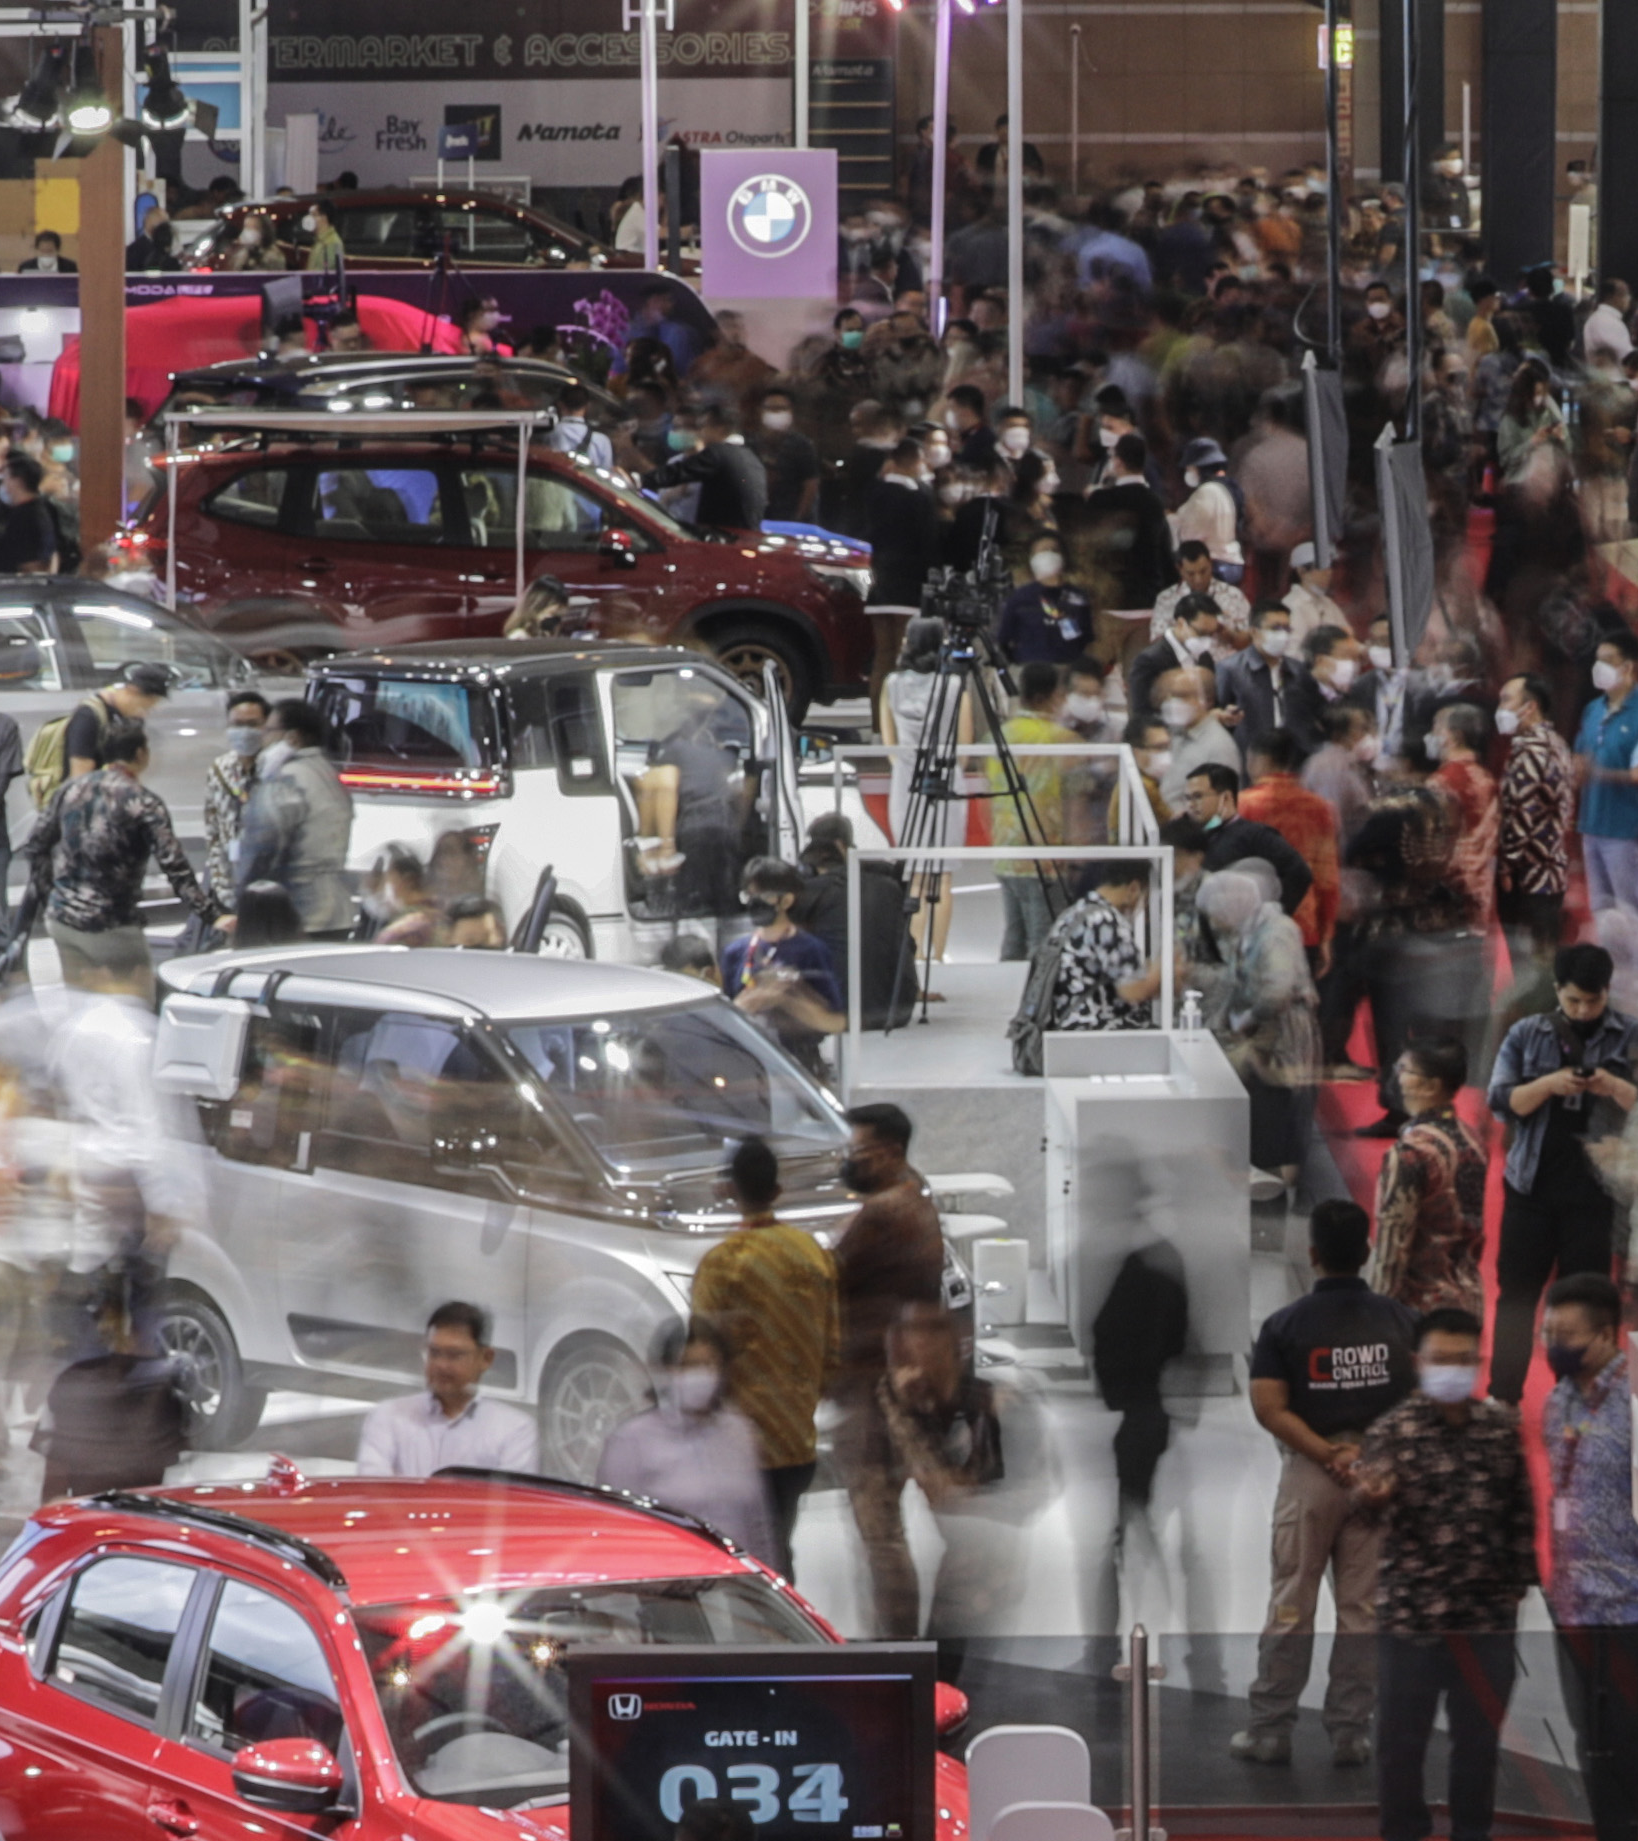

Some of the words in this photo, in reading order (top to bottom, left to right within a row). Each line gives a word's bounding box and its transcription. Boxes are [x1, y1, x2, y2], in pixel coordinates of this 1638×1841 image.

[203, 33, 483, 68] ERMARKET
[524, 32, 791, 66] ACCESSORIES
[387, 115, 423, 137] Bay
[375, 131, 427, 152] Fresh
[673, 131, 722, 144] ASTRA
[734, 178, 803, 207] BMW
[704, 1730, 759, 1747] GATE
[774, 1730, 798, 1746] IN
[660, 1763, 849, 1823] 034
